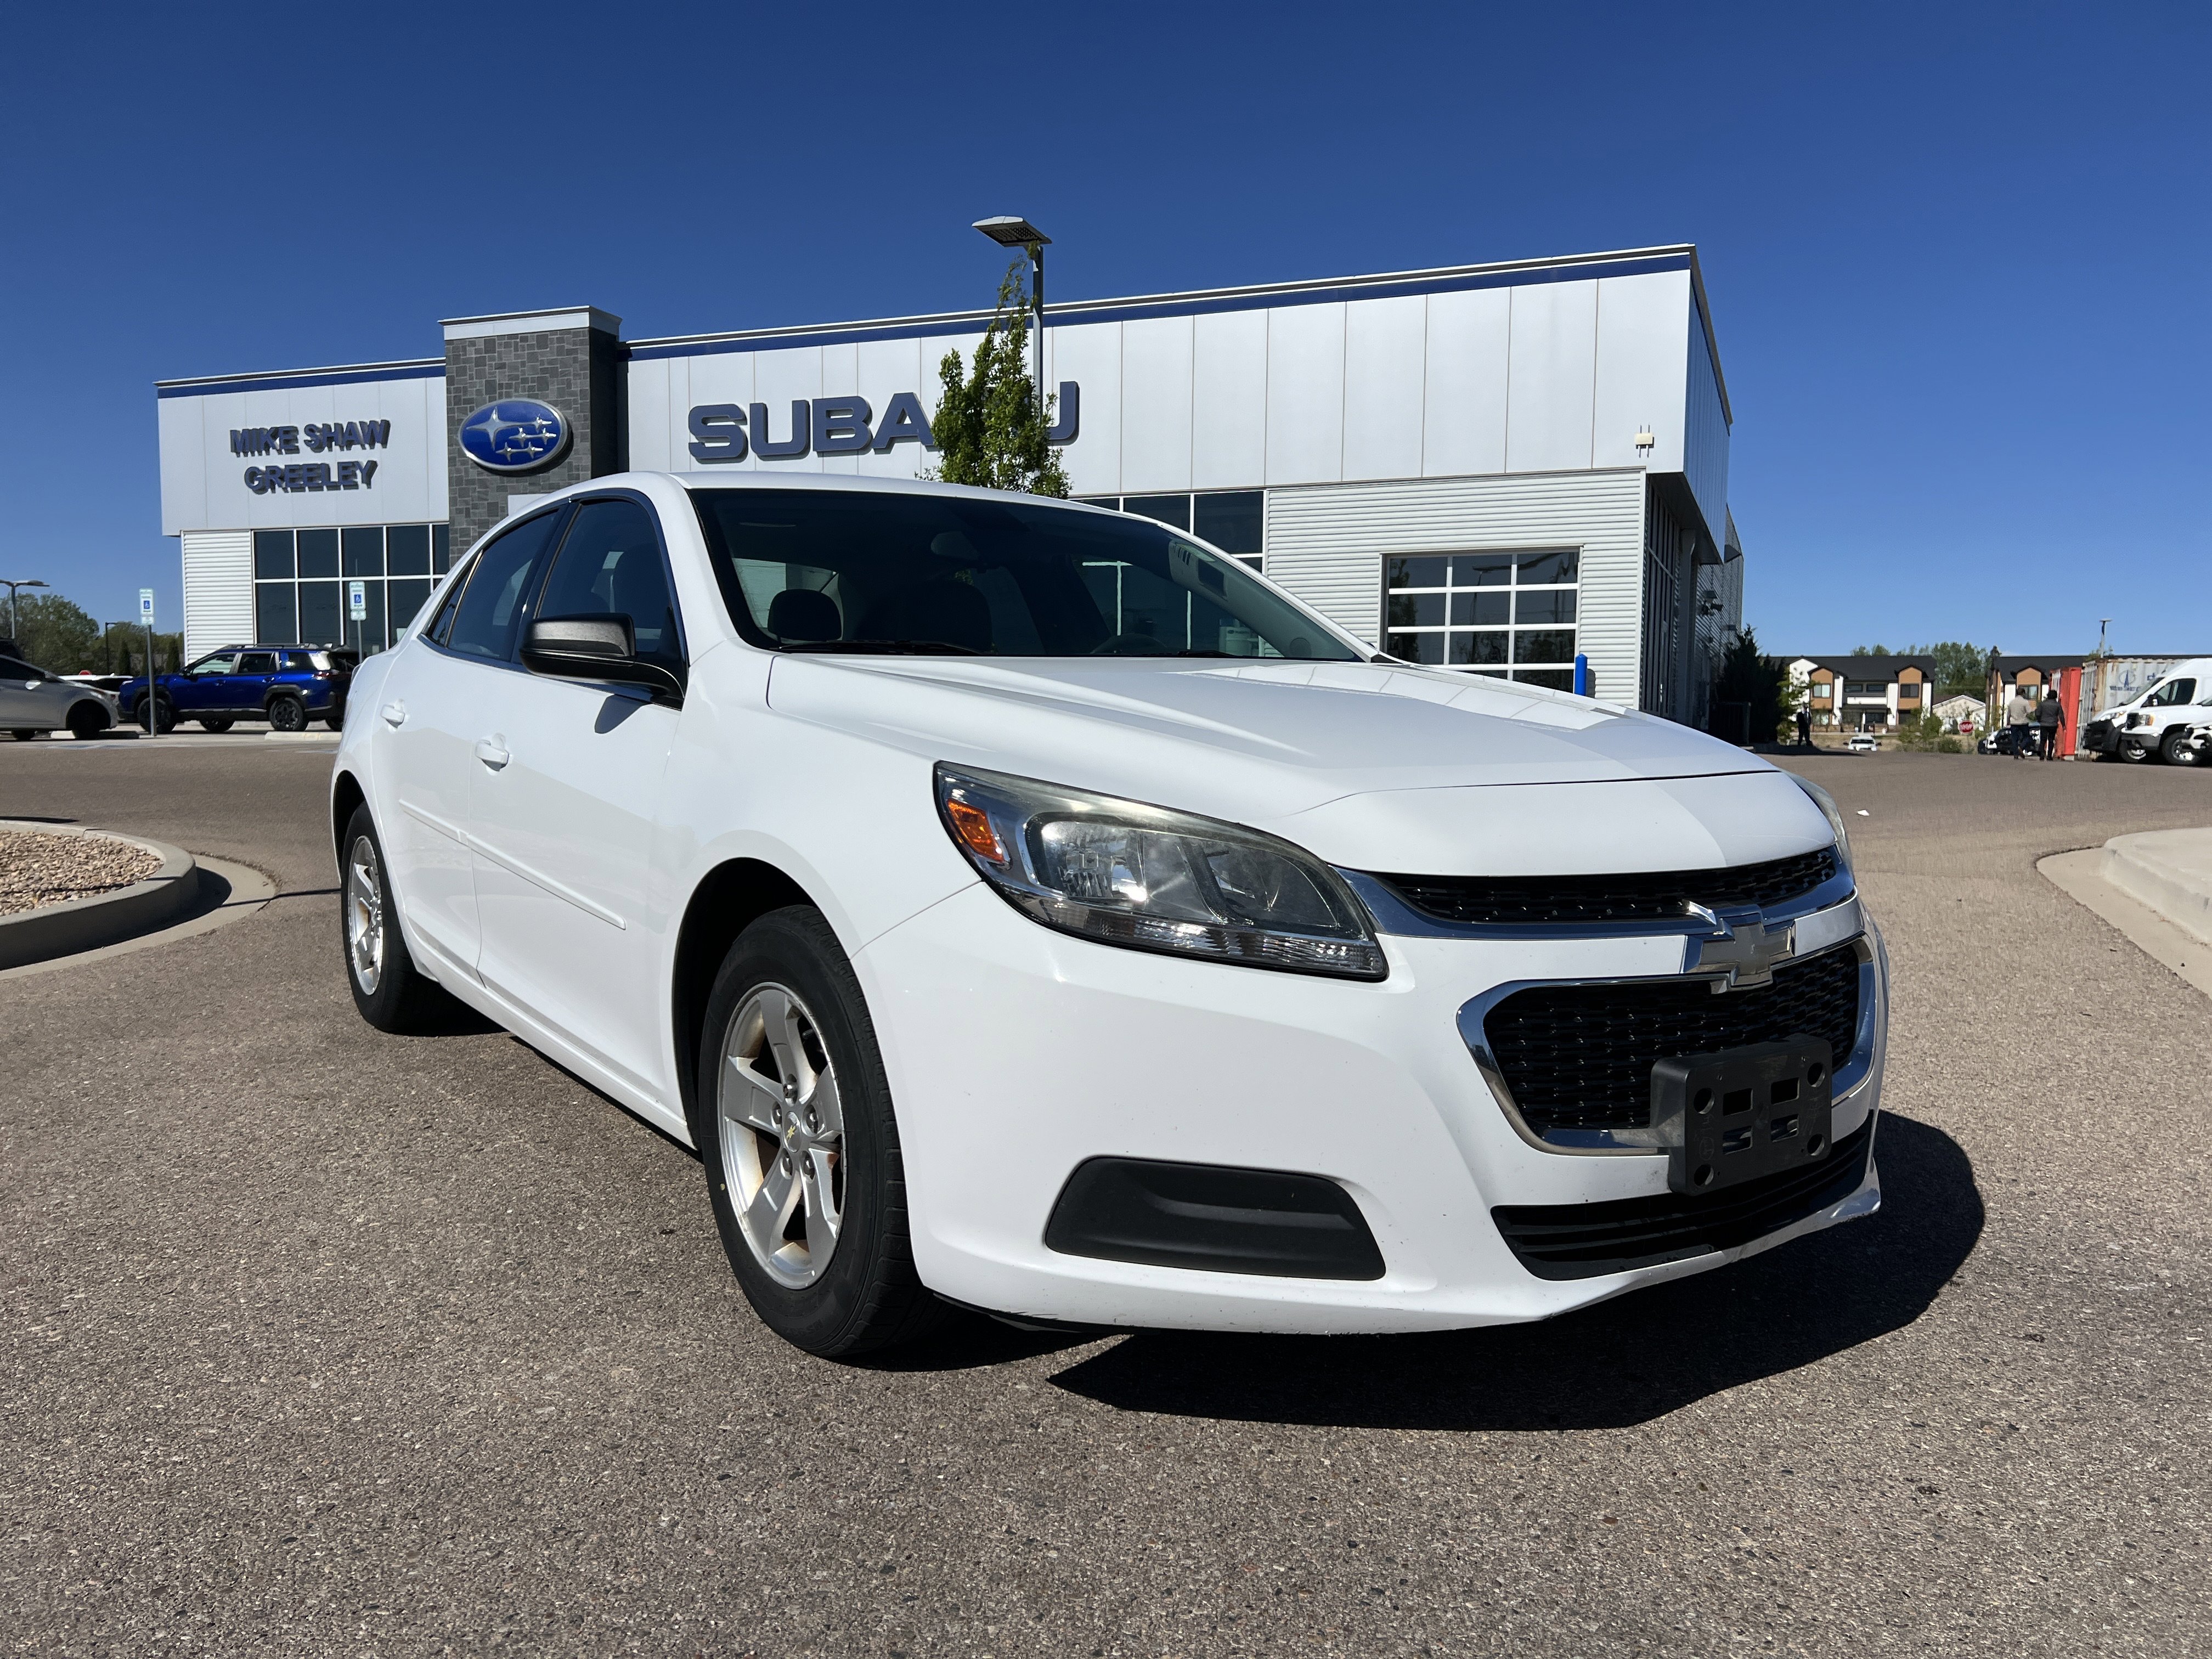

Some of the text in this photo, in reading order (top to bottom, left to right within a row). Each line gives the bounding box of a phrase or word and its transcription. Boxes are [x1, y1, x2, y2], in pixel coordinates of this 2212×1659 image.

[230, 420, 390, 456] MIKE SHAW
[689, 381, 1079, 462] SUBAU
[244, 460, 377, 493] GREELEY
